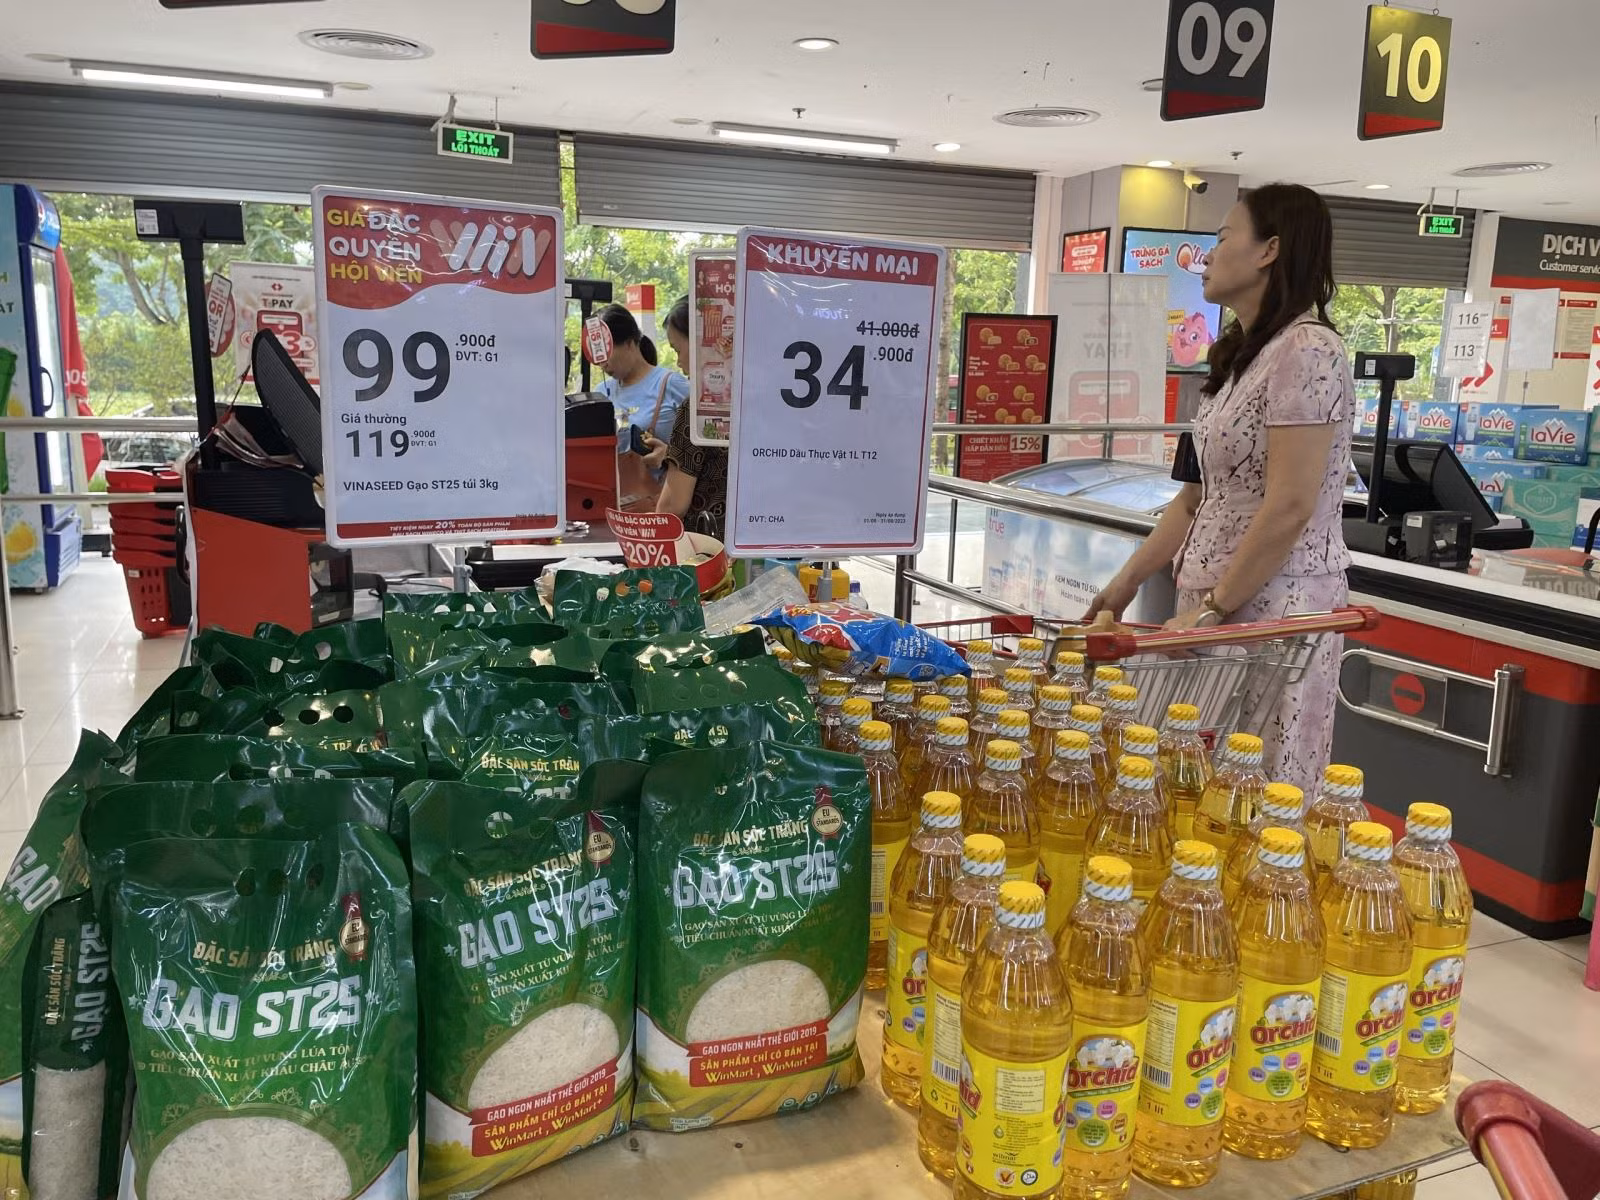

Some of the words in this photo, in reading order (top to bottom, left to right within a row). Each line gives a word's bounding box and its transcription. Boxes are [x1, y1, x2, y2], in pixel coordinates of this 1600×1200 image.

[1177, 1, 1267, 78] 09
[1376, 32, 1442, 103] 10
[455, 129, 496, 145] EXIT
[451, 141, 468, 153] LỐI
[469, 145, 500, 157] THOÁT
[1432, 216, 1455, 226] EXIT
[328, 231, 421, 261] QUYỀN
[1542, 234, 1587, 260] DỊCH
[330, 261, 370, 284] HỘI
[876, 253, 919, 281] MẠI
[1539, 259, 1580, 273] Customer
[209, 300, 224, 318] QR
[262, 298, 294, 309] T-PAY
[1457, 313, 1479, 326] 116
[591, 332, 602, 342] QR
[856, 320, 920, 340] 41.000đ
[282, 331, 301, 355] 3
[1453, 345, 1475, 357] 113
[342, 328, 451, 403] 99
[455, 334, 496, 348] .900đ
[455, 351, 483, 363] ĐVT:
[485, 352, 499, 363] G1
[780, 341, 869, 411] 34
[873, 347, 913, 363] .900đ
[341, 413, 362, 424] Giá
[365, 413, 407, 427] thường
[345, 429, 410, 458] 119
[1011, 436, 1041, 451] 15%
[752, 448, 788, 458] ORCHID
[789, 448, 806, 459] Dầu
[808, 449, 830, 460] Thực
[832, 449, 847, 460] Vật
[850, 450, 859, 460] 1L
[862, 450, 877, 460] T12
[343, 481, 404, 491] VINASEED
[406, 481, 428, 492] Gạo
[431, 480, 460, 490] ST25
[463, 478, 476, 489] túi
[479, 479, 499, 491] 3kg
[435, 521, 456, 529] 20%
[639, 515, 668, 525] QUYỀN
[749, 515, 767, 523] ĐVT:
[768, 515, 785, 523] CHA
[627, 543, 671, 566] 20%
[1066, 577, 1080, 589] NGON
[481, 753, 504, 773] ĐẶC
[506, 756, 528, 769] SẢN
[530, 757, 551, 772] SÓC
[553, 757, 580, 771] TRĂN
[822, 808, 830, 817] EU
[815, 817, 839, 827] STANDARDS
[592, 833, 602, 843] EU
[587, 841, 613, 856] STANDARDS
[750, 850, 840, 900] ST25
[350, 922, 361, 933] EU
[458, 909, 525, 974] GẠO
[528, 877, 618, 945] ST25
[77, 922, 110, 984] ST25
[192, 941, 223, 967] ĐẶC
[510, 965, 537, 980] XUẤT
[490, 984, 525, 999] CHUẨN
[71, 988, 110, 1042] GẠO
[142, 977, 241, 1045] GẠO
[252, 974, 362, 1039] ST25
[702, 1045, 720, 1056] GẠO
[721, 1041, 743, 1052] NGON
[744, 1034, 766, 1049] NHẤT
[767, 1033, 782, 1045] THẾ
[783, 1029, 799, 1041] GIỚI
[800, 1026, 817, 1038] 2019
[150, 1048, 175, 1060] GẠO
[207, 1053, 241, 1068] XUẤT
[300, 1044, 327, 1058] LÚA
[700, 1056, 720, 1071] SẢN
[721, 1052, 750, 1068] PHẨM
[752, 1048, 768, 1063] CHỈ
[770, 1048, 782, 1059] CÓ
[784, 1044, 802, 1057] BÁN
[803, 1042, 818, 1055] TẠI
[299, 1058, 337, 1073] CHÂU
[704, 1067, 754, 1083] WinMart
[487, 1107, 506, 1122] GẠO
[507, 1098, 532, 1116] NGON
[534, 1089, 557, 1109] NHẤT
[557, 1083, 573, 1101] THẾ
[574, 1078, 590, 1094] GIỚI
[589, 1068, 607, 1084] 2019
[484, 1123, 505, 1138] SẢN
[509, 1111, 539, 1132] PHẨM
[541, 1106, 558, 1122] CHỈ
[560, 1101, 572, 1115] CÓ
[574, 1093, 592, 1109] BÁN
[593, 1084, 608, 1100] TẠI
[490, 1128, 542, 1151] WinMart
